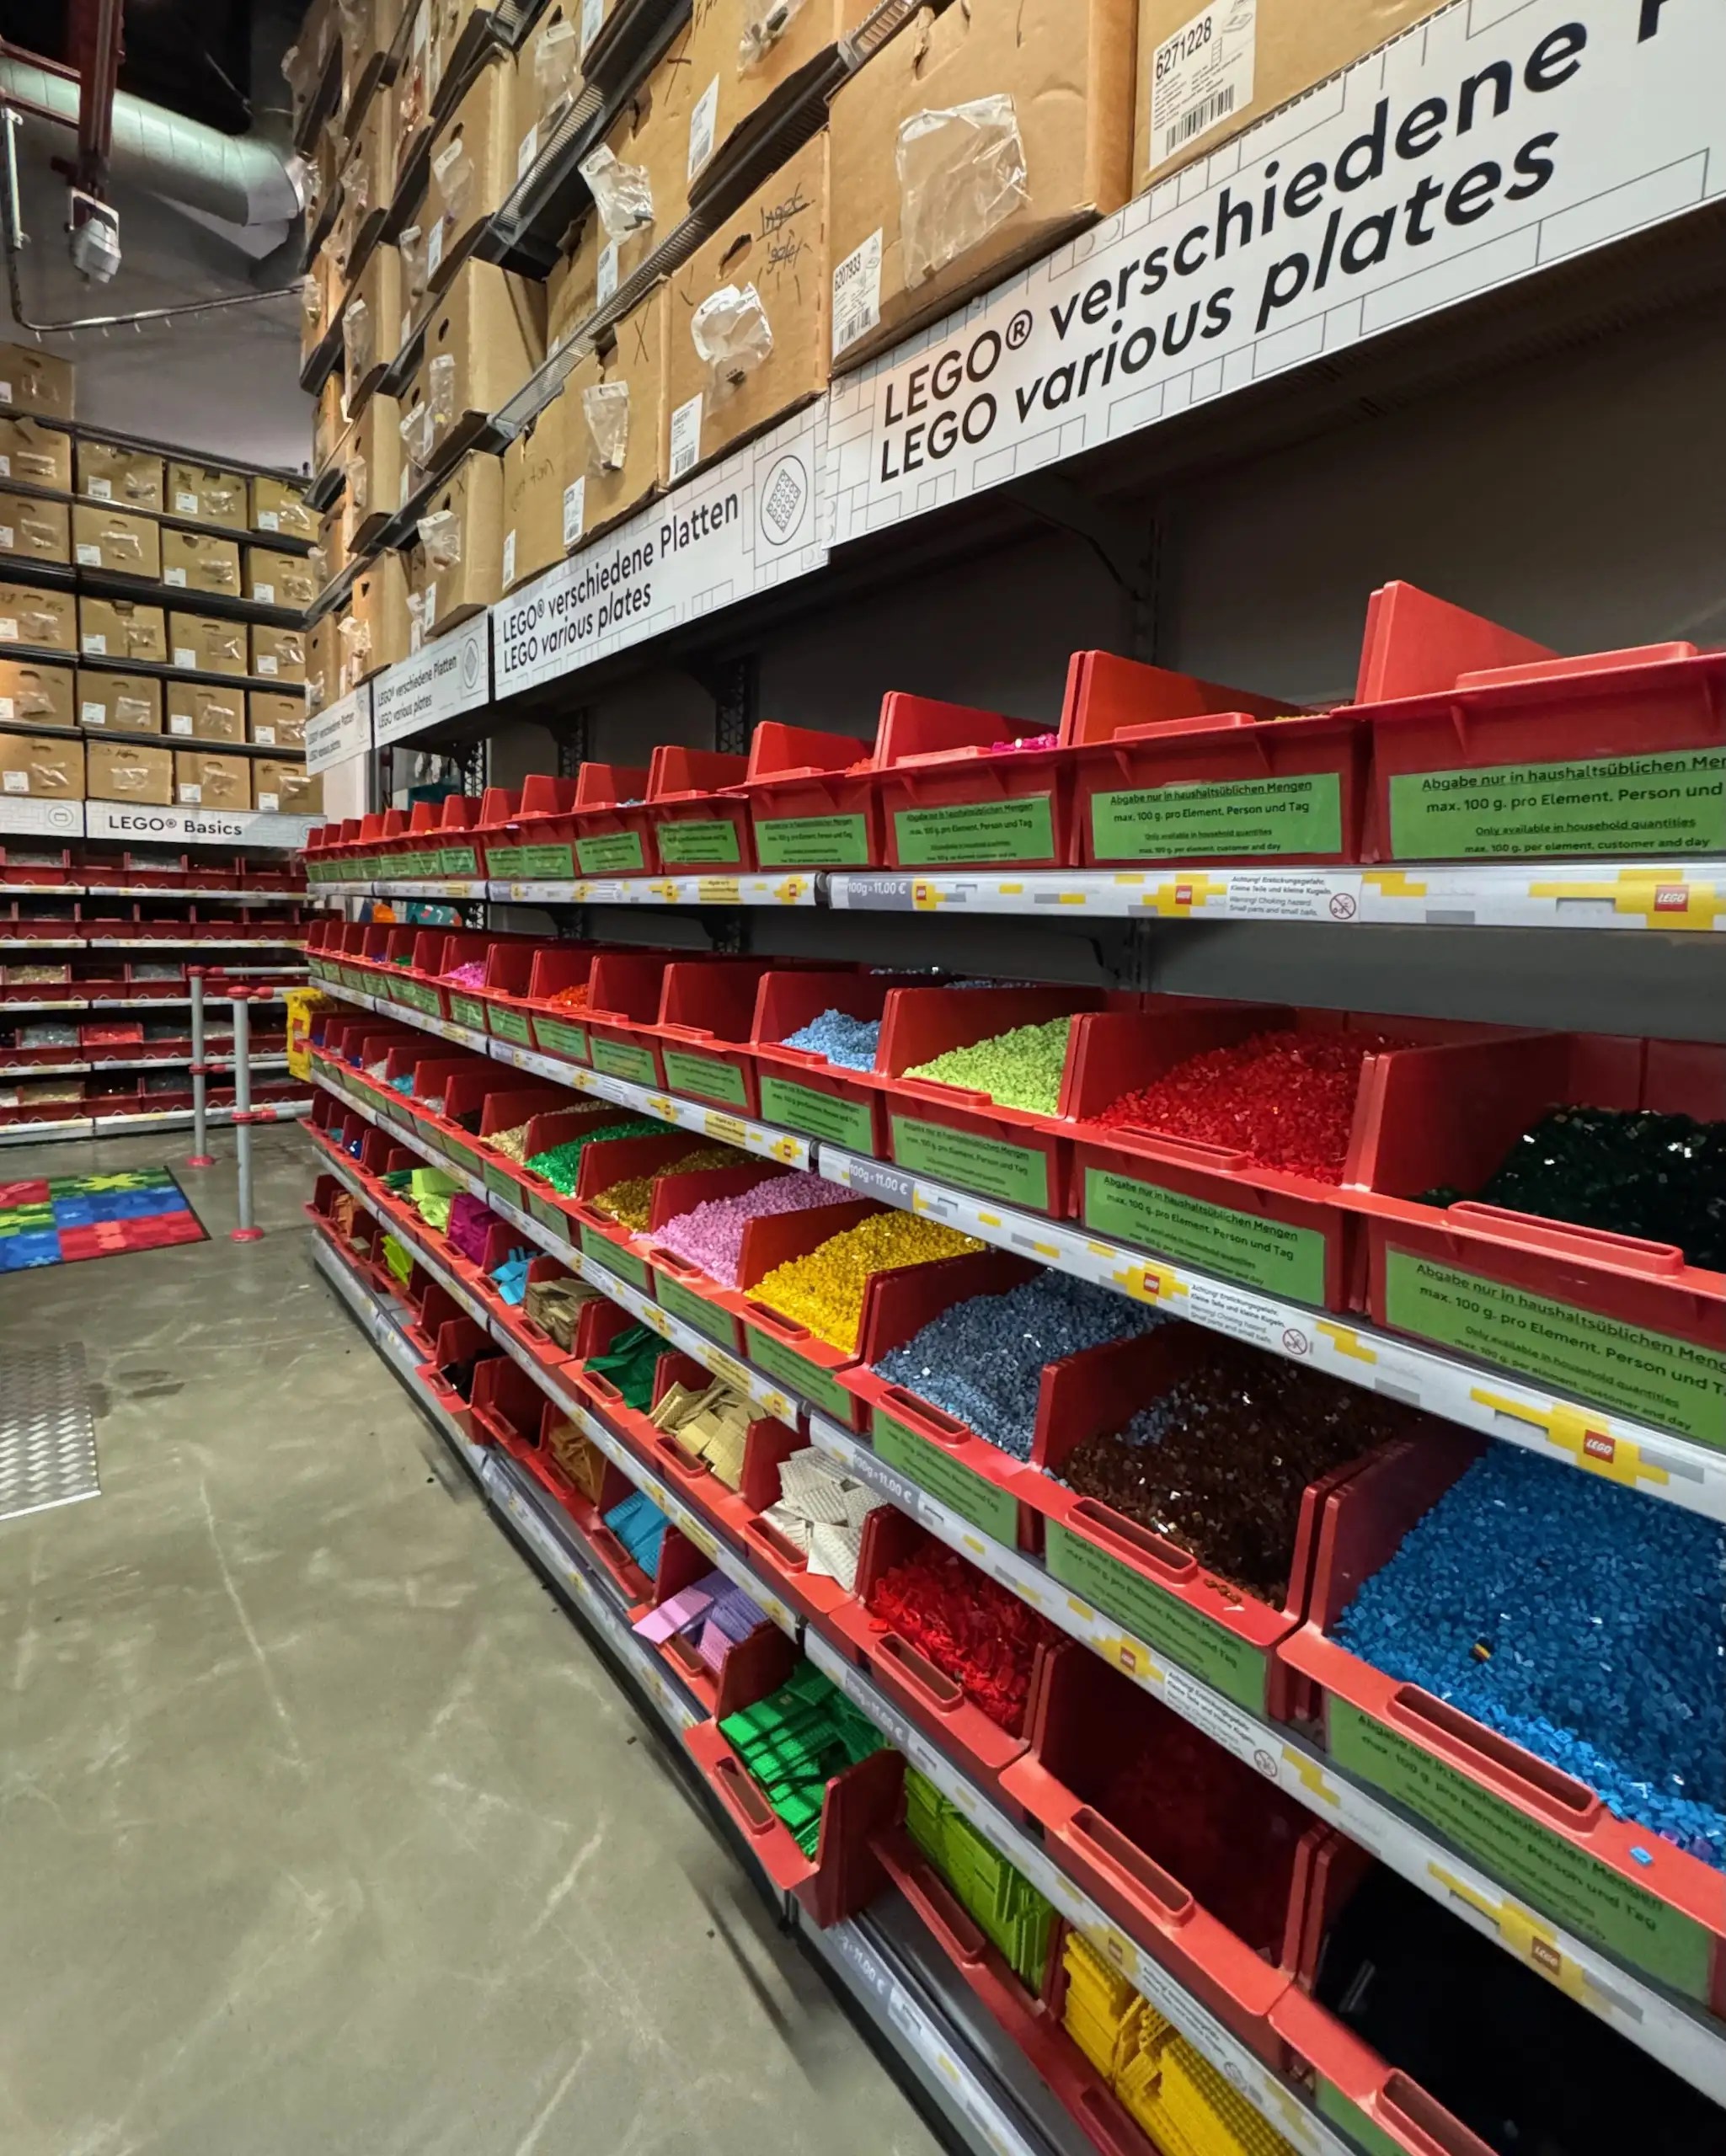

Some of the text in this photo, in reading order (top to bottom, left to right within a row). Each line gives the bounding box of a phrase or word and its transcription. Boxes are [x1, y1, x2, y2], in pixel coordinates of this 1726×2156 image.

[1156, 16, 1212, 80] 6271228
[884, 22, 1588, 428] LEGO® verschiedene
[881, 131, 1559, 483] LEGO various plates
[503, 493, 739, 644] LEGO® verschiedene Platten
[504, 583, 651, 674] LEGO various plates
[1111, 782, 1312, 805] Abgabe nur in haushaltsüblichen Mengen
[1422, 776, 1478, 791] Abgabe
[1482, 774, 1506, 785] nur
[1510, 771, 1524, 783] in
[1528, 760, 1686, 782] haushaltsüblichen
[1427, 802, 1461, 813] max.
[1464, 798, 1489, 810] 100
[1511, 797, 1536, 810] pro
[1618, 788, 1680, 801] Person
[1686, 782, 1723, 798] und
[109, 815, 243, 836] LEGO® Basics
[1138, 811, 1153, 820] 100
[1165, 810, 1181, 820] pro
[1227, 805, 1263, 815] Person
[1265, 802, 1285, 813] und
[1288, 802, 1309, 813] Tag
[1476, 817, 1696, 835] Only available in household quantities
[1658, 893, 1685, 903] LEGO
[1104, 1176, 1298, 1242] Abgabe nur in haushaltsüblichen Mengen
[1129, 1198, 1144, 1210] 100
[1155, 1209, 1170, 1219] pro
[1213, 1226, 1248, 1245] Person
[1250, 1240, 1271, 1252] und
[1273, 1245, 1295, 1261] Tag
[1417, 1264, 1469, 1289] Abgabe
[1473, 1283, 1499, 1298] nur
[1501, 1288, 1515, 1304] in
[1519, 1295, 1674, 1354] haushaltsüblichen
[1419, 1287, 1451, 1305] max.
[1456, 1297, 1480, 1313] 100
[1501, 1314, 1526, 1329] pro
[1606, 1348, 1667, 1376] Person
[1671, 1371, 1708, 1390] und
[1586, 1437, 1612, 1455] LEGO
[1396, 1753, 1418, 1774] 100
[1435, 1782, 1458, 1802] pro
[1527, 1844, 1584, 1886] Person
[1586, 1883, 1620, 1908] und
[1626, 1903, 1657, 1931] Tag
